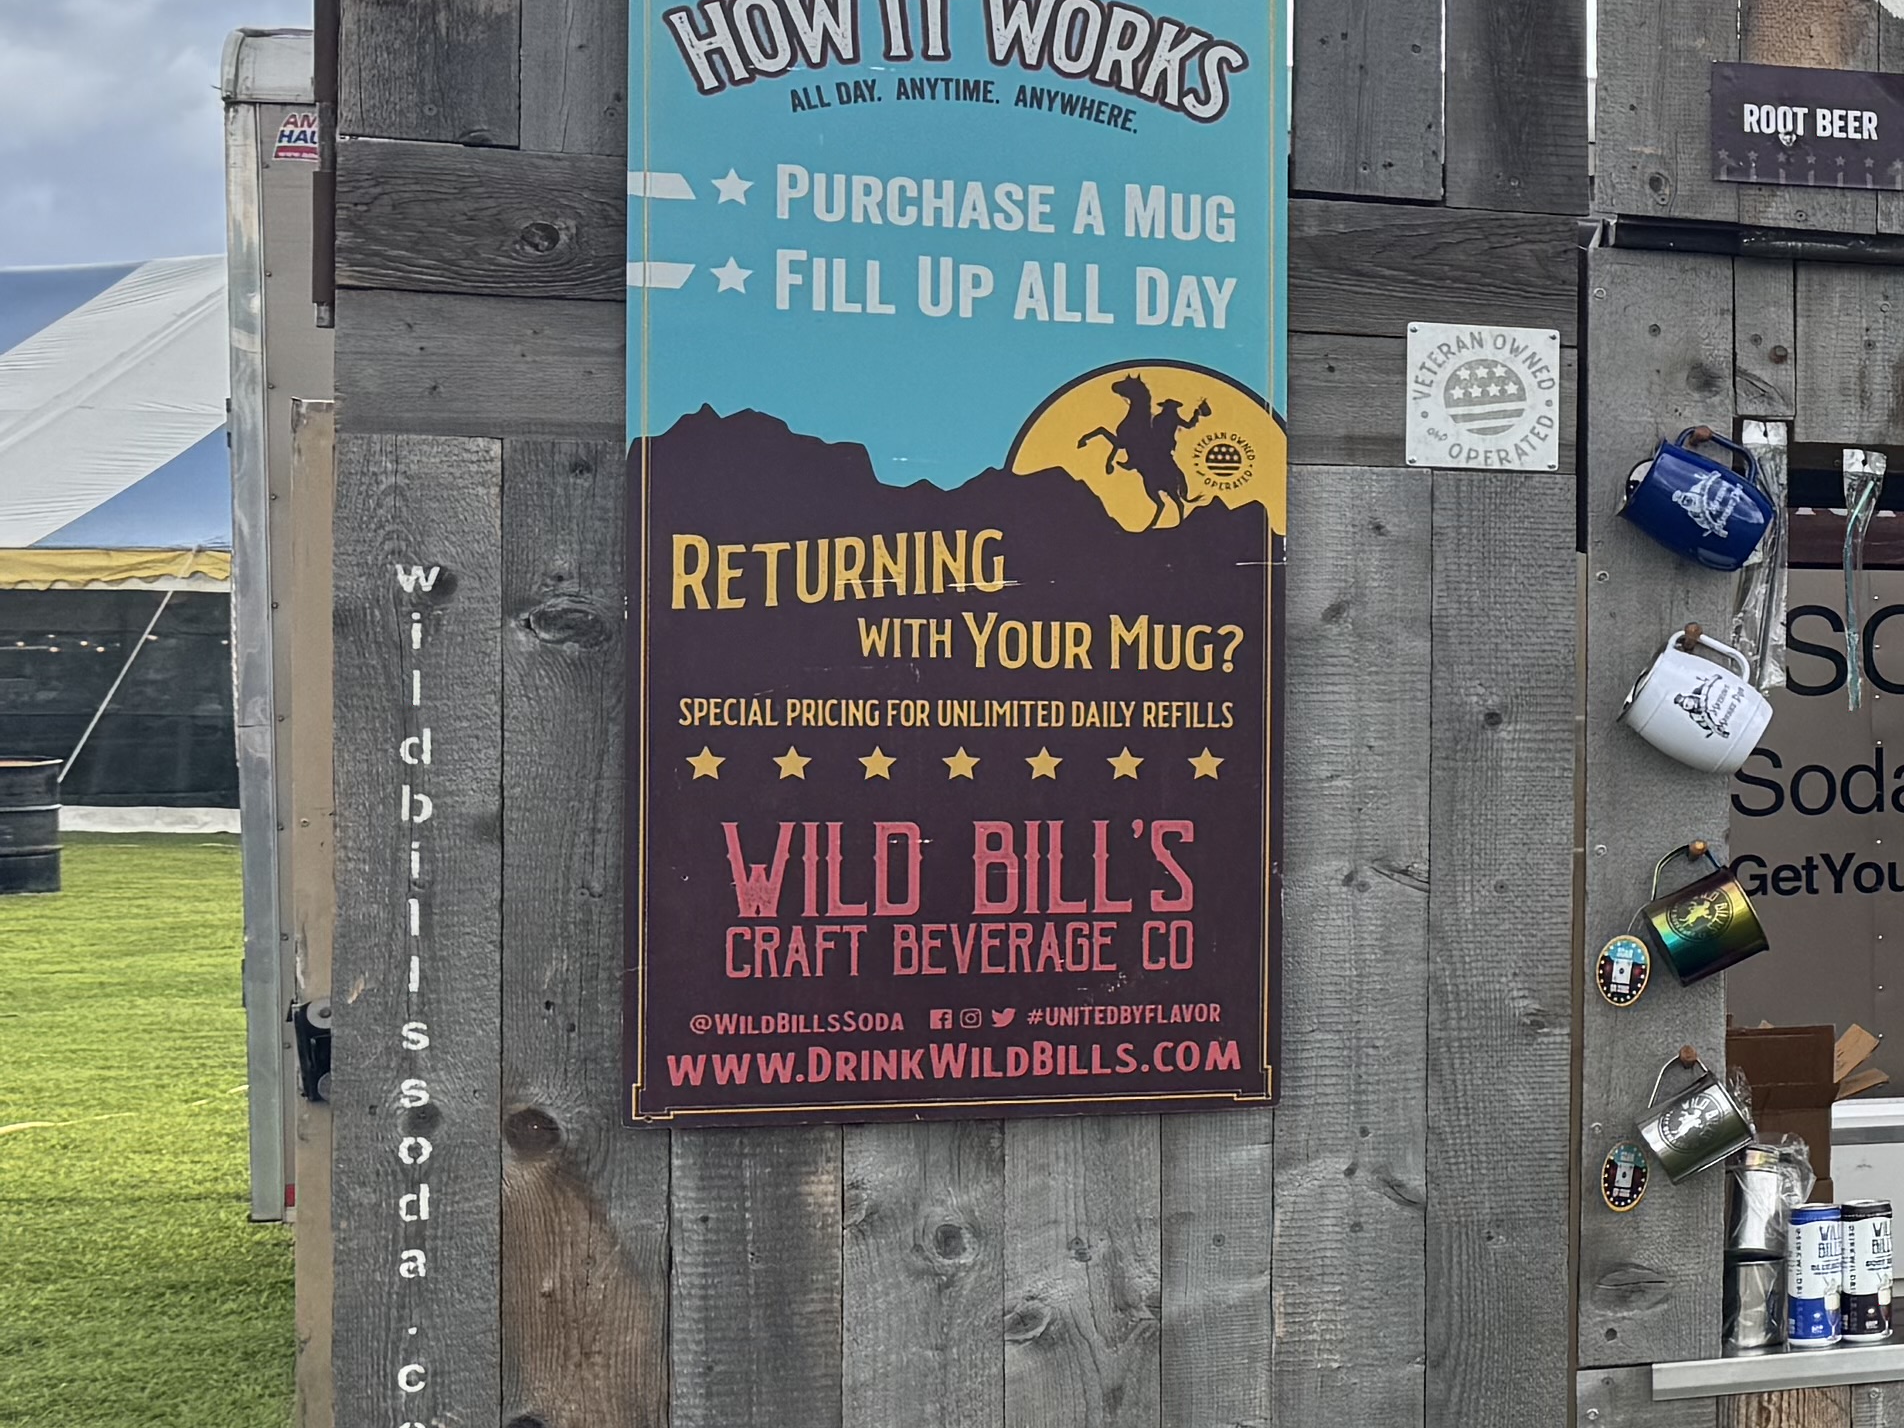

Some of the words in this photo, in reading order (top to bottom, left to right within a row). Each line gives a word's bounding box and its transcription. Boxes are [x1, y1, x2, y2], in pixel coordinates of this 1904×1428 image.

[790, 84, 831, 114] ALL
[837, 78, 882, 106] DAY.
[896, 78, 1001, 105] ANYTIME.
[1014, 84, 1138, 134] ANYWHERE.
[1743, 103, 1805, 136] ROOT
[1816, 108, 1878, 141] BEER
[775, 163, 1056, 235] PURCHASE
[1072, 181, 1106, 236] A
[1124, 185, 1237, 243] MUG
[775, 249, 896, 316] FILL
[917, 255, 994, 319] UP
[1012, 261, 1115, 325] ALL
[1135, 267, 1237, 330] DAY
[1413, 332, 1484, 401] VETERAN
[1493, 334, 1555, 390] OWNED
[1449, 415, 1554, 466] OPERATED
[670, 529, 1005, 610] RETURNING
[858, 618, 953, 659] WITH
[961, 612, 1093, 670] YOUR
[1109, 614, 1244, 673] MUG?
[679, 698, 778, 727] SPECIAL
[786, 699, 879, 728] PRICING
[887, 700, 929, 727] FOR
[937, 699, 1065, 728] UNLIMITED
[1071, 700, 1135, 728] DAILY
[1142, 701, 1233, 728] REFILLS
[721, 822, 922, 917] WILD
[972, 819, 1194, 914] BILL'S
[725, 925, 867, 978] CRAFT
[892, 922, 1117, 976] BEVERAGE
[1142, 921, 1193, 971] CO
[690, 1011, 904, 1035] @WILDBILLSSODA
[1027, 1004, 1220, 1026] #UNITEDBYFLAVOR
[667, 1040, 1241, 1086] WWW.DRINKWILDBILLS.COM
